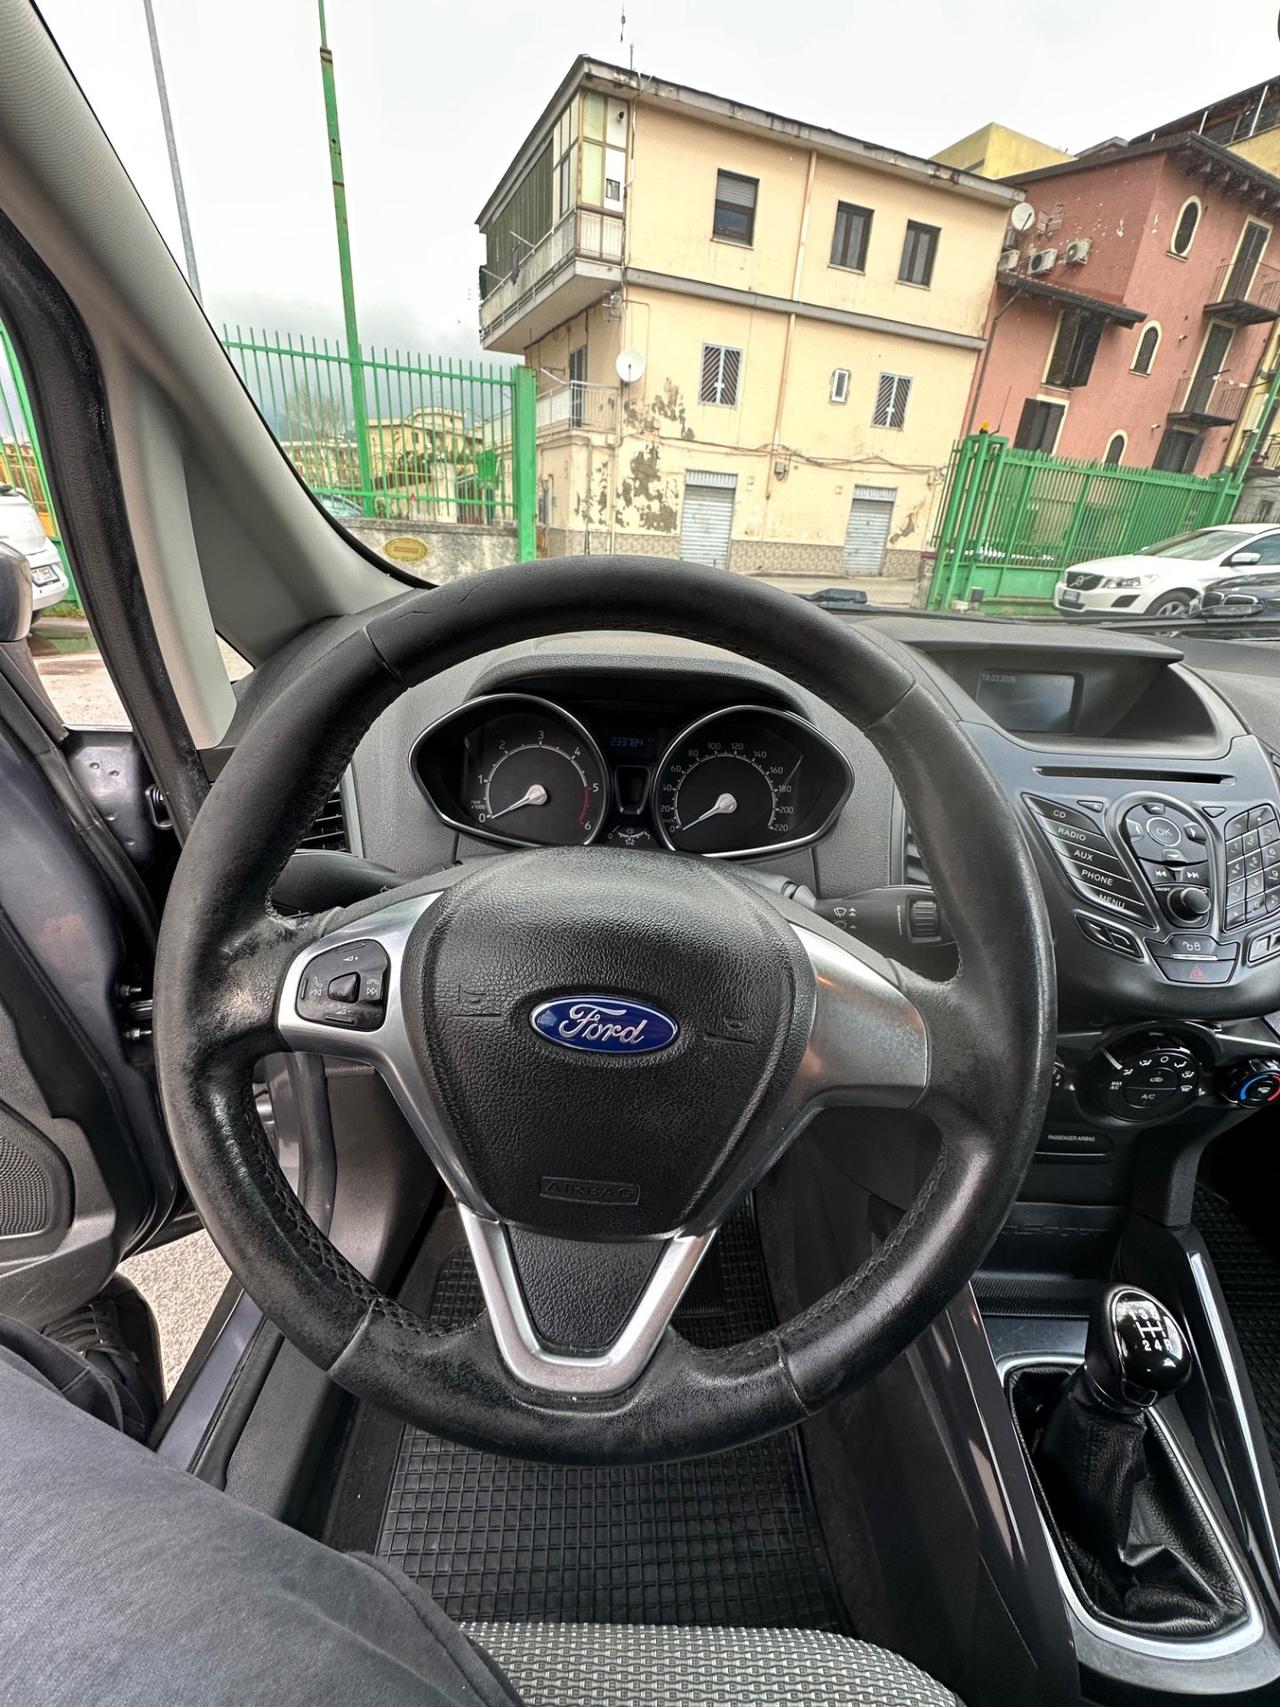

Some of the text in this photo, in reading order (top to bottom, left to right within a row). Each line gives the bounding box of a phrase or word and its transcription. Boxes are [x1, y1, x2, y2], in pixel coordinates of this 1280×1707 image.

[537, 730, 545, 739] 3
[498, 741, 506, 750] 2
[707, 742, 721, 750] 100
[730, 742, 744, 750] 120
[574, 747, 581, 756] 4
[688, 749, 699, 757] 80
[753, 750, 767, 759] 140
[670, 764, 682, 773] 60
[770, 766, 784, 775] 160
[477, 774, 483, 784] 1
[592, 783, 599, 792] 5
[778, 785, 792, 793] 180
[660, 805, 671, 813] 20
[780, 806, 794, 814] 200
[478, 813, 486, 823] 0
[1053, 810, 1066, 818] CD
[584, 821, 592, 830] 6
[669, 825, 676, 833] 0
[774, 824, 788, 832] 220
[1057, 827, 1086, 841] RADIO
[1155, 826, 1172, 836] OK
[1073, 849, 1094, 861] AUX
[1081, 869, 1113, 886] PHONE
[1099, 894, 1126, 909] MENU
[559, 1003, 648, 1045] Ford
[544, 1181, 635, 1199] AIRBAG
[1139, 1309, 1149, 1320] 3
[1142, 1339, 1173, 1351] 2 4 R
